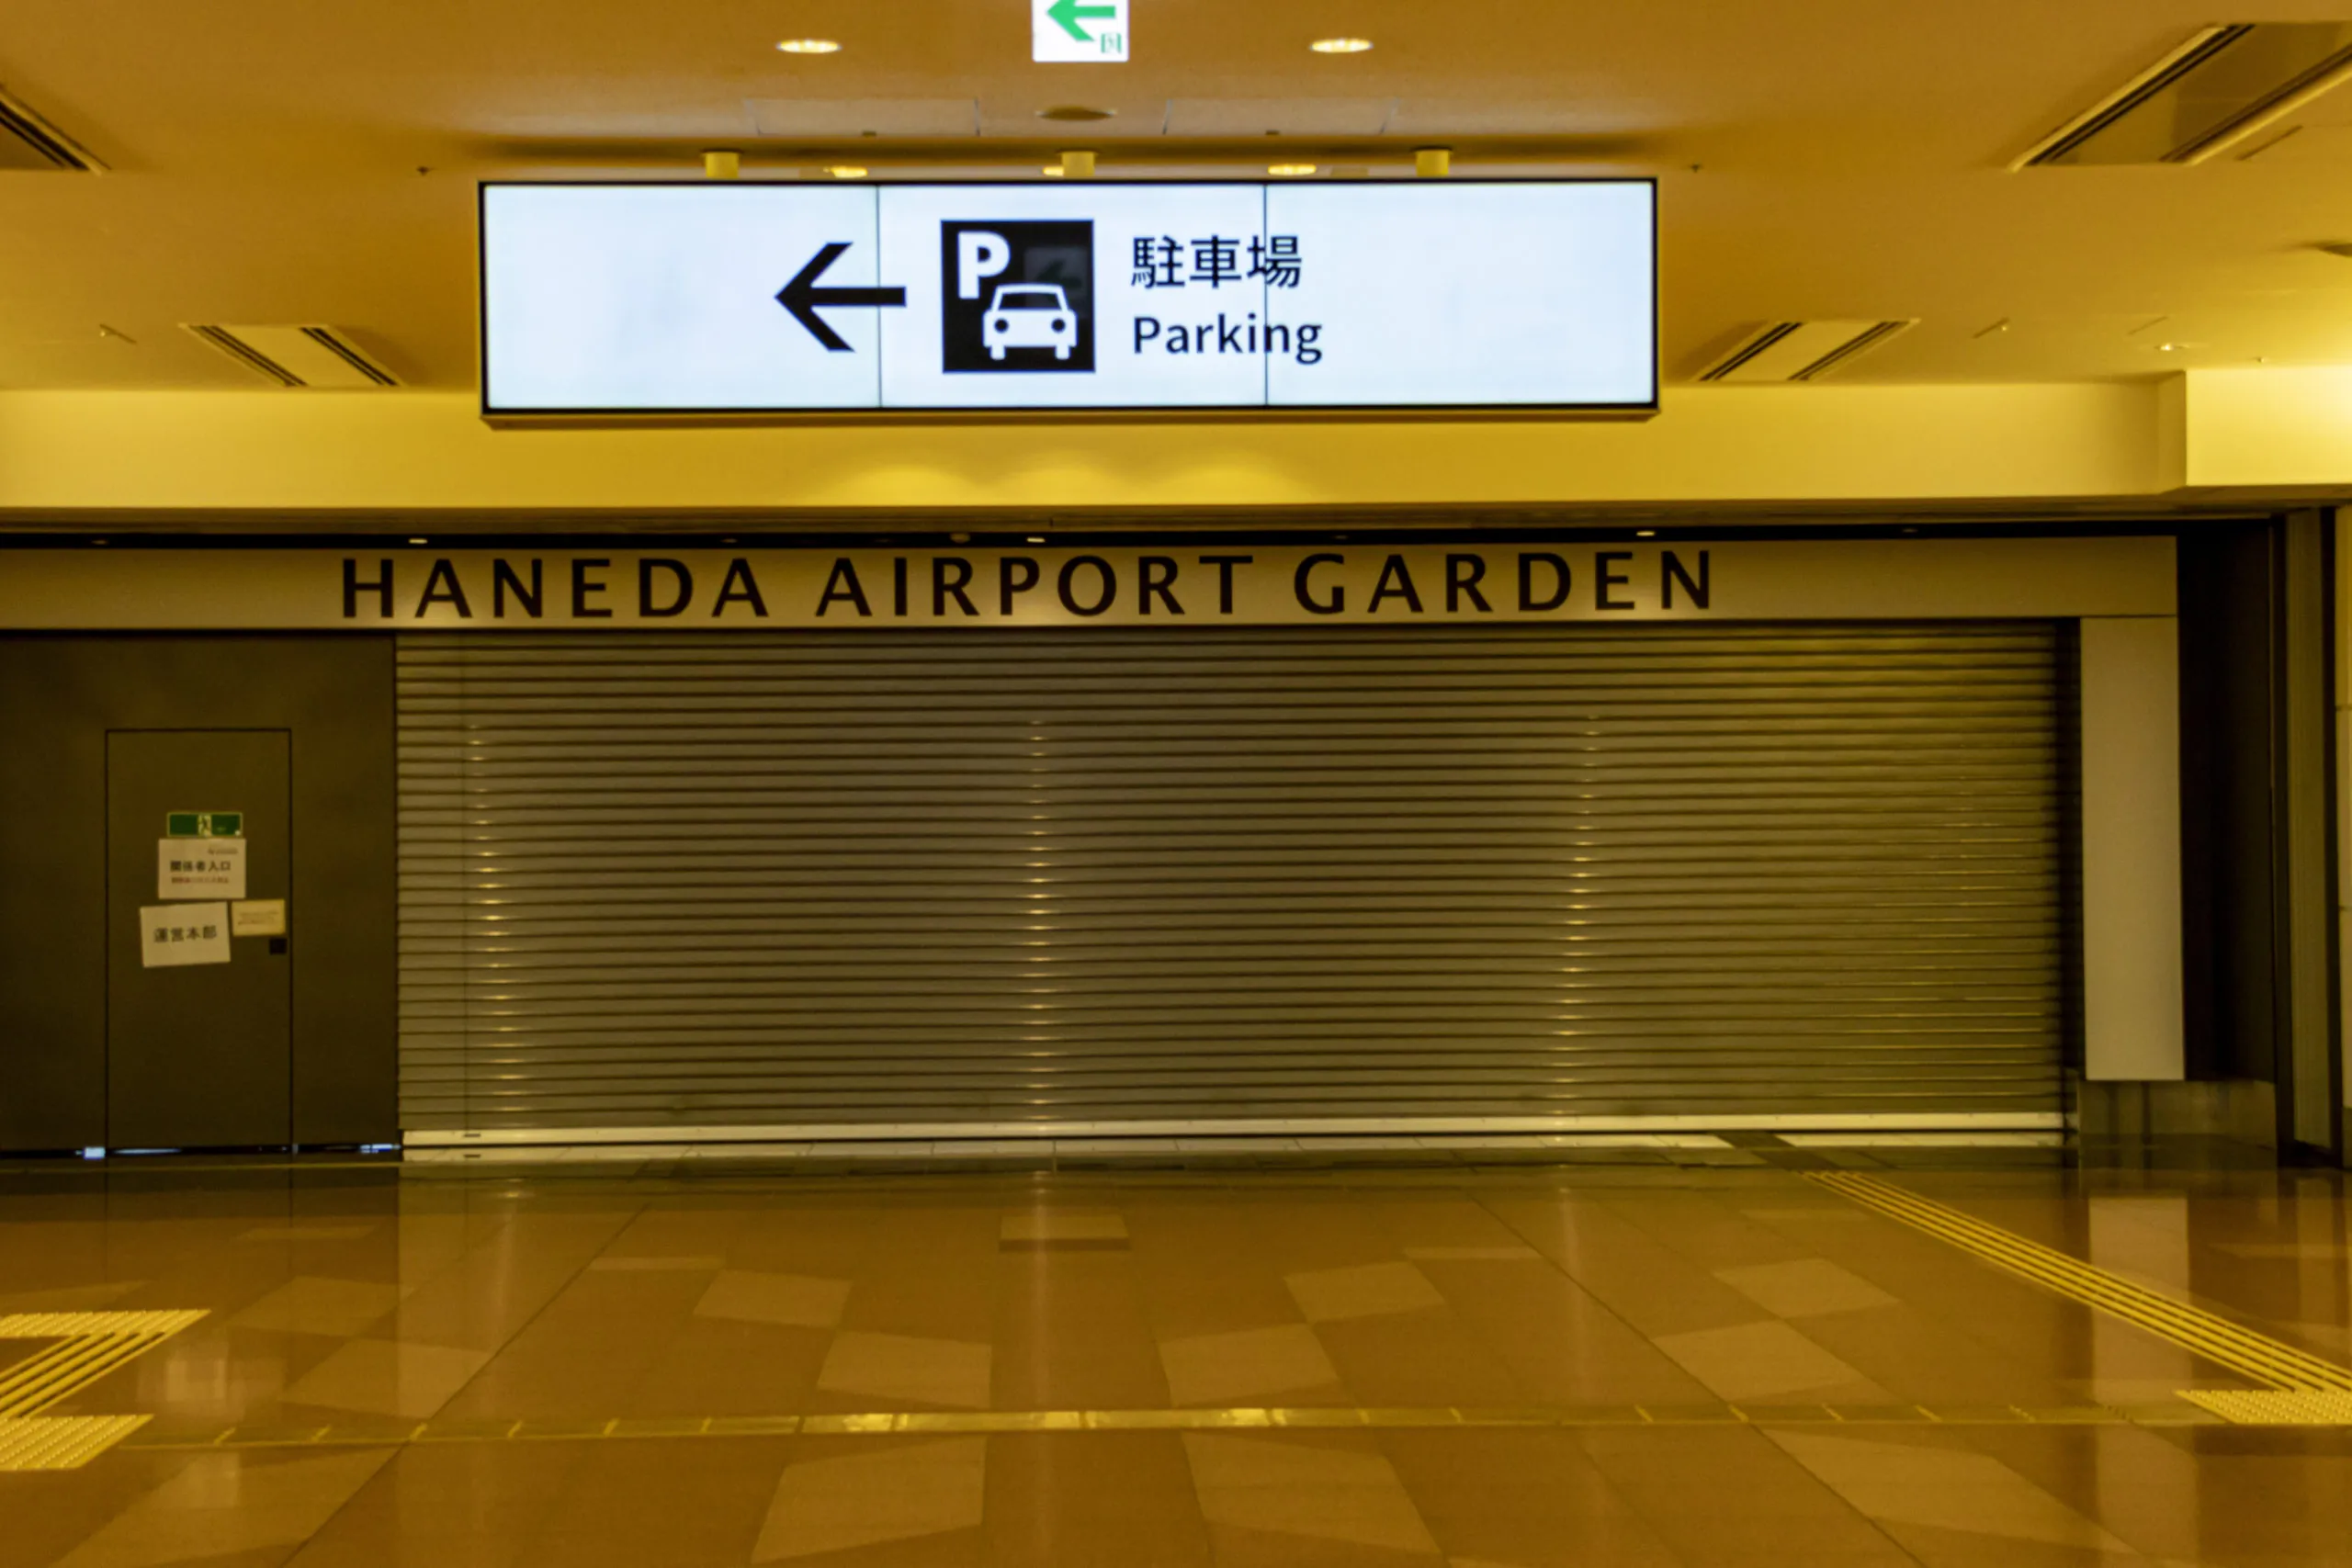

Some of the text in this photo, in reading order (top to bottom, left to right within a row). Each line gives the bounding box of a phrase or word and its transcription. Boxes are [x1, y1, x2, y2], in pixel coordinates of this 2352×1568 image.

[1131, 234, 1303, 288] 駐車場
[1133, 312, 1323, 365] Parking
[342, 549, 1711, 619] HANEDA AIRPORT GARDEN
